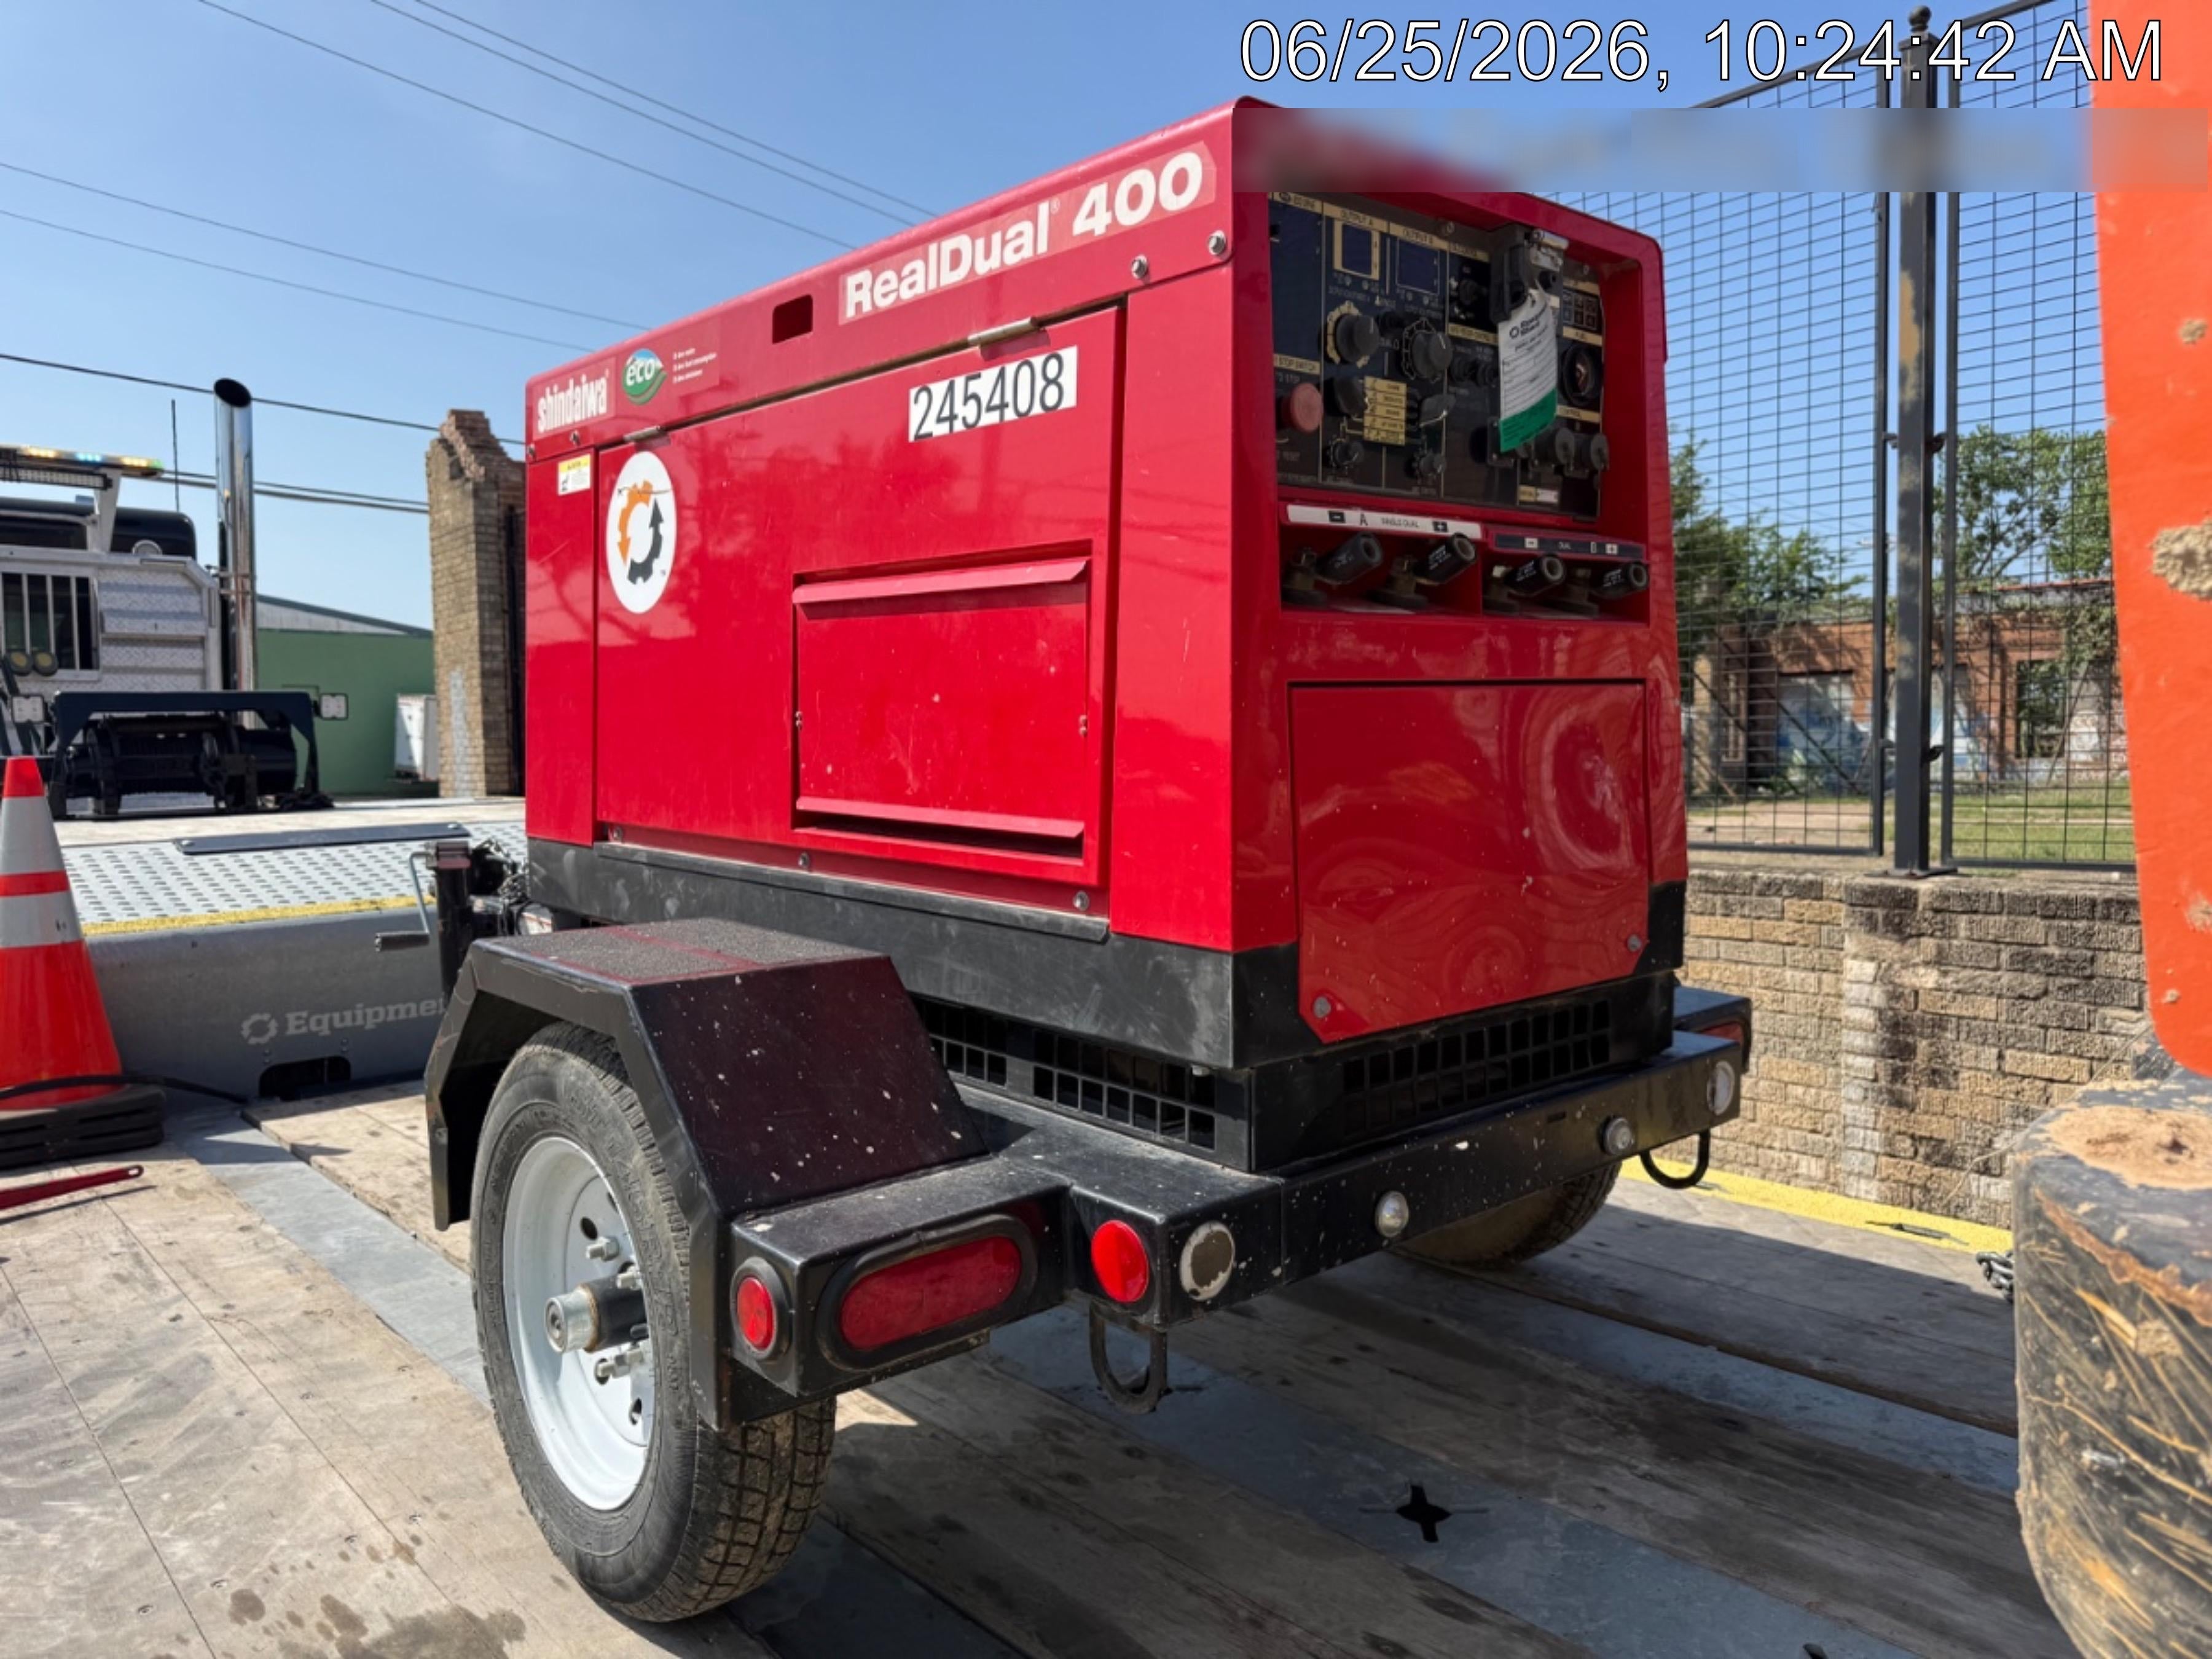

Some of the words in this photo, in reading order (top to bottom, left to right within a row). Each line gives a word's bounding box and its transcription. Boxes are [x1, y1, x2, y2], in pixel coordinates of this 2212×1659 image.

[1073, 151, 1204, 237] 400
[538, 374, 608, 433] shindaiwa
[912, 351, 1065, 441] 245408
